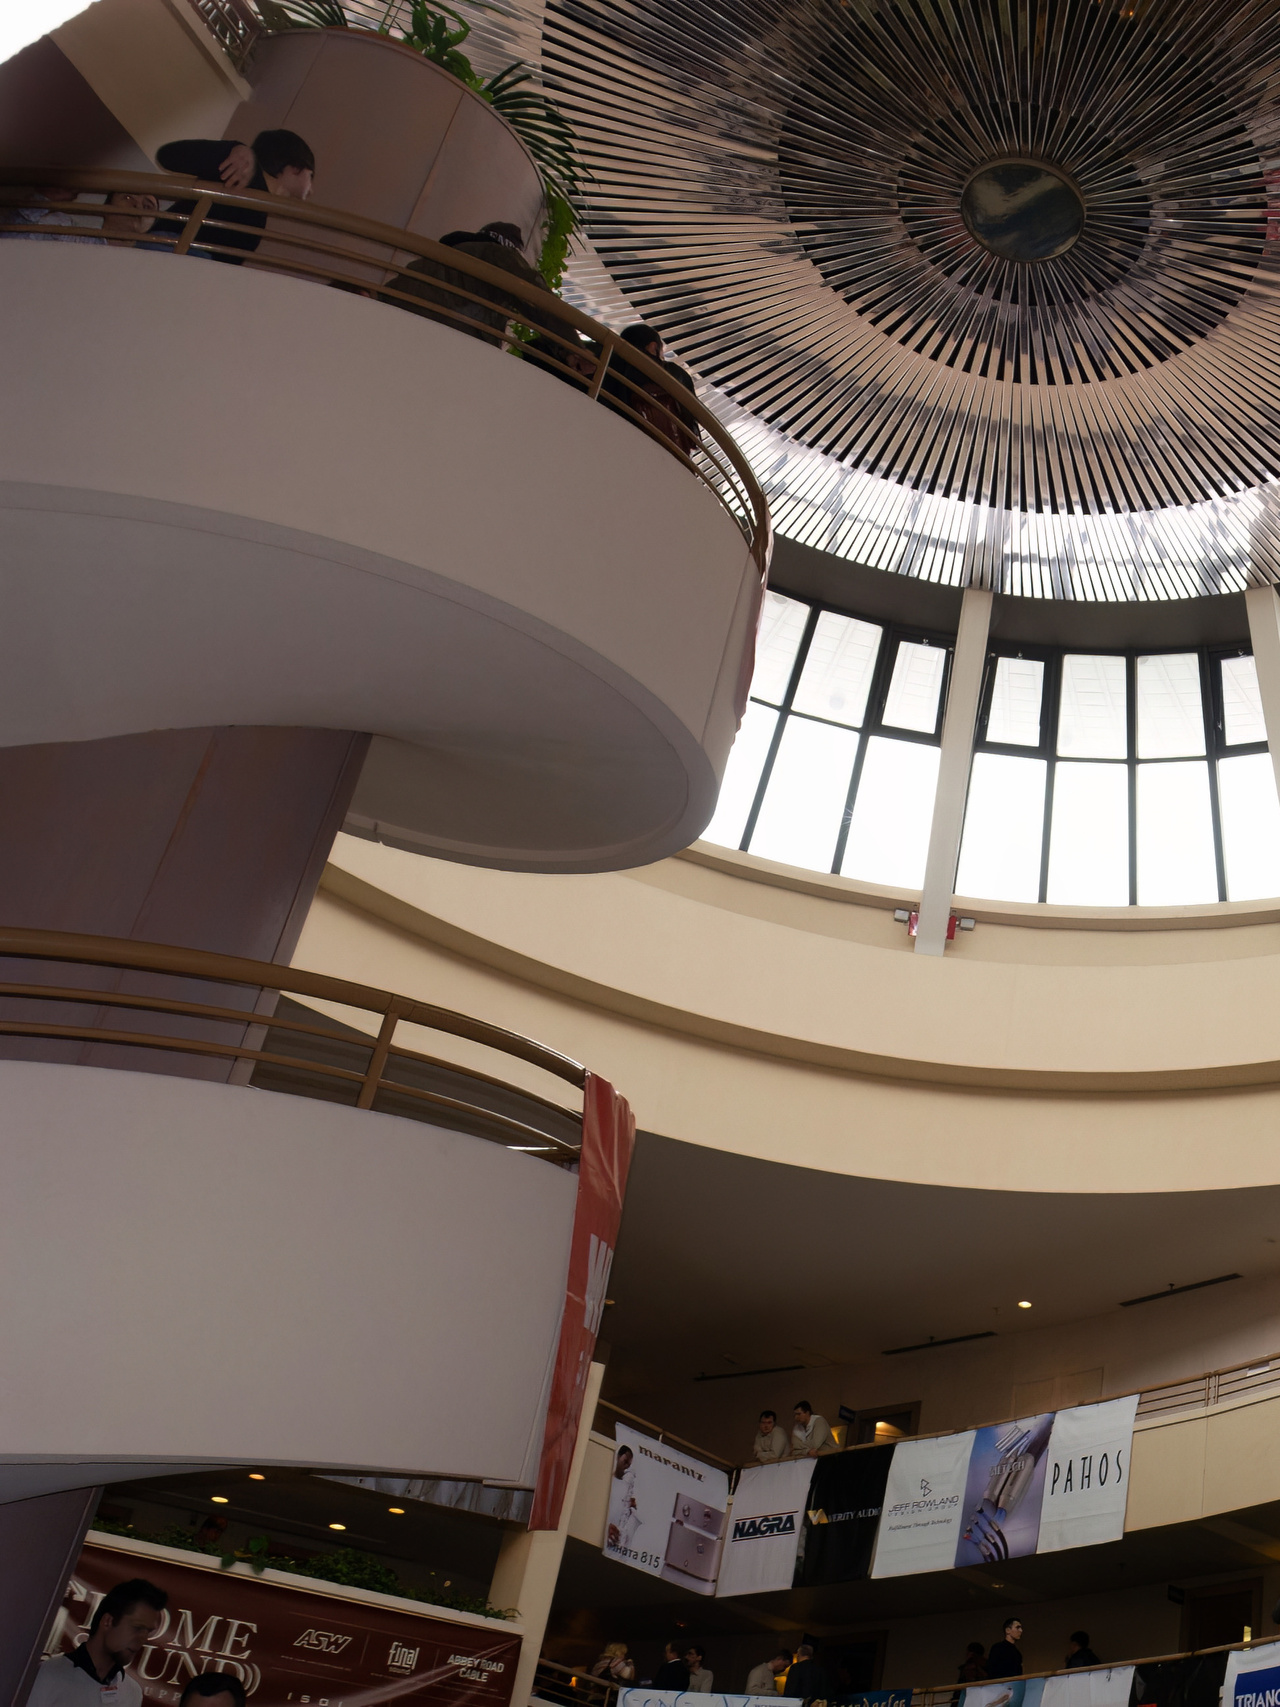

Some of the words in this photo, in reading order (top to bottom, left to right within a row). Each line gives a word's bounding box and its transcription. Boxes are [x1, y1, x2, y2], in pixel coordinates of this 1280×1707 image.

[638, 1445, 706, 1483] marantz
[911, 1495, 959, 1509] ROWLAND
[732, 1514, 796, 1539] NAGRA
[640, 1551, 660, 1568] 815
[293, 1629, 353, 1654] ASW
[447, 1654, 480, 1668] ABBEY
[481, 1658, 505, 1673] ROAD
[459, 1668, 489, 1683] CABLE
